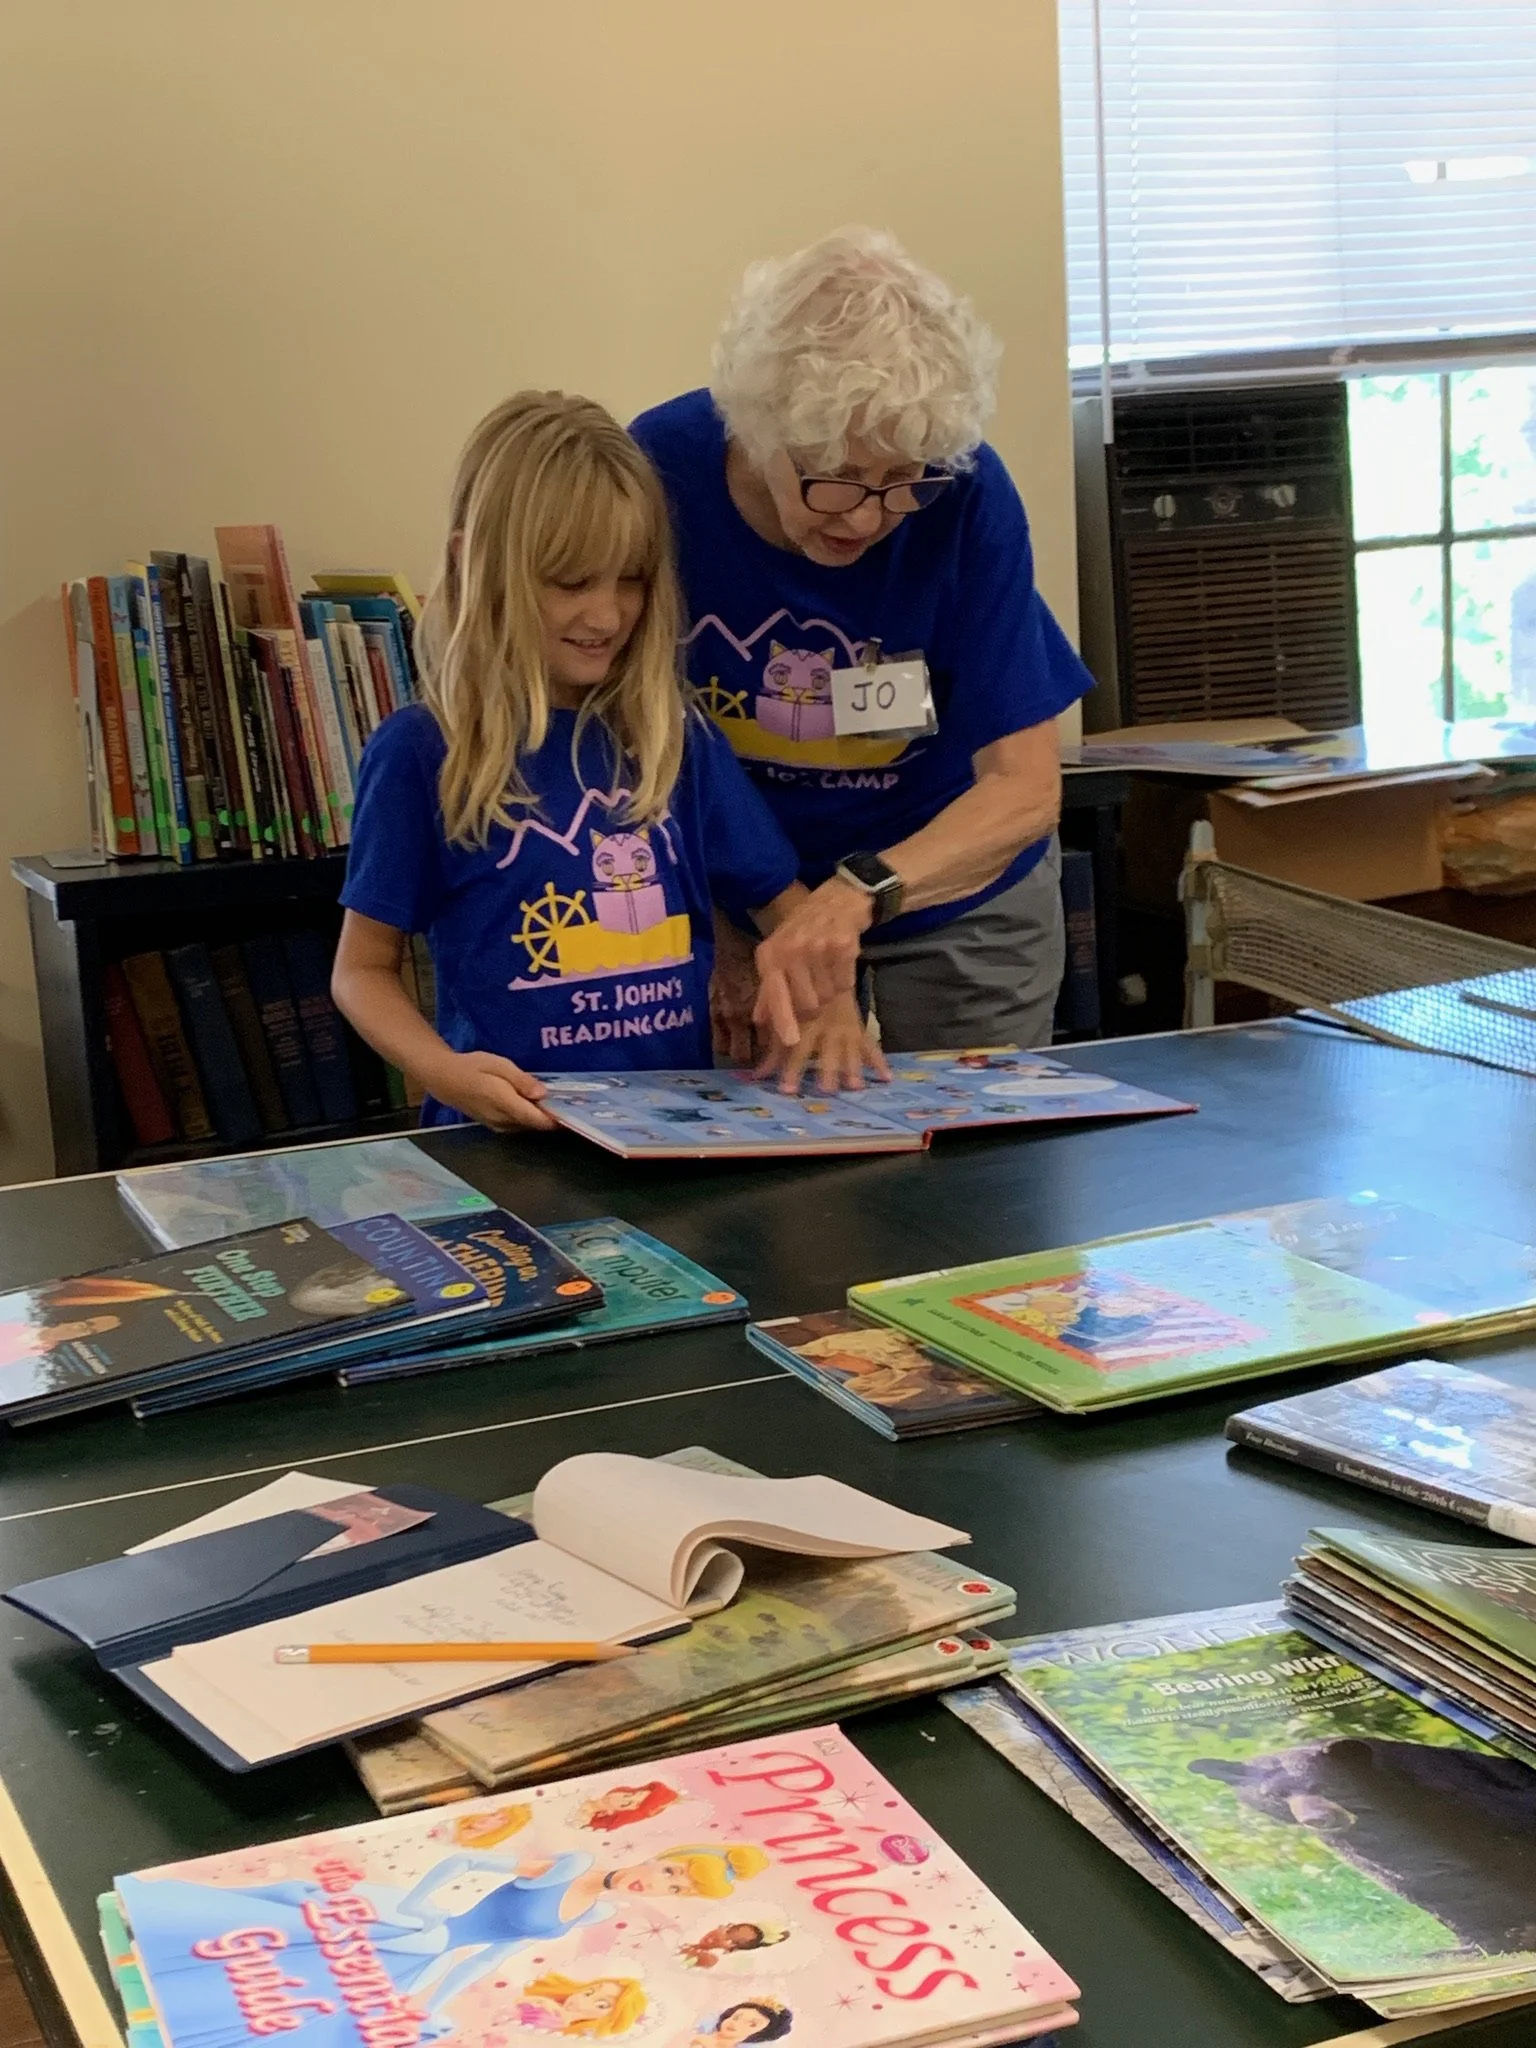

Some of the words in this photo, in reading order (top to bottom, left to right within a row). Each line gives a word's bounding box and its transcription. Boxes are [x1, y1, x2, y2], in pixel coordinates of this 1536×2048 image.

[850, 680, 896, 712] JO
[104, 705, 126, 784] MAMMALS
[820, 772, 899, 790] CAMP
[571, 990, 609, 1014] ST.
[614, 976, 683, 1012] JOHN'S
[540, 1015, 653, 1050] READING
[653, 1004, 695, 1031] CAM
[182, 1264, 269, 1322] FURTHER
[215, 1249, 257, 1274] One
[239, 1270, 287, 1298] Step
[430, 1235, 508, 1307] ATHERIN
[576, 1235, 692, 1302] Cmputer
[1152, 1667, 1275, 1697] Bearing
[705, 1751, 980, 2001] Princess
[191, 1927, 337, 2036] Guide
